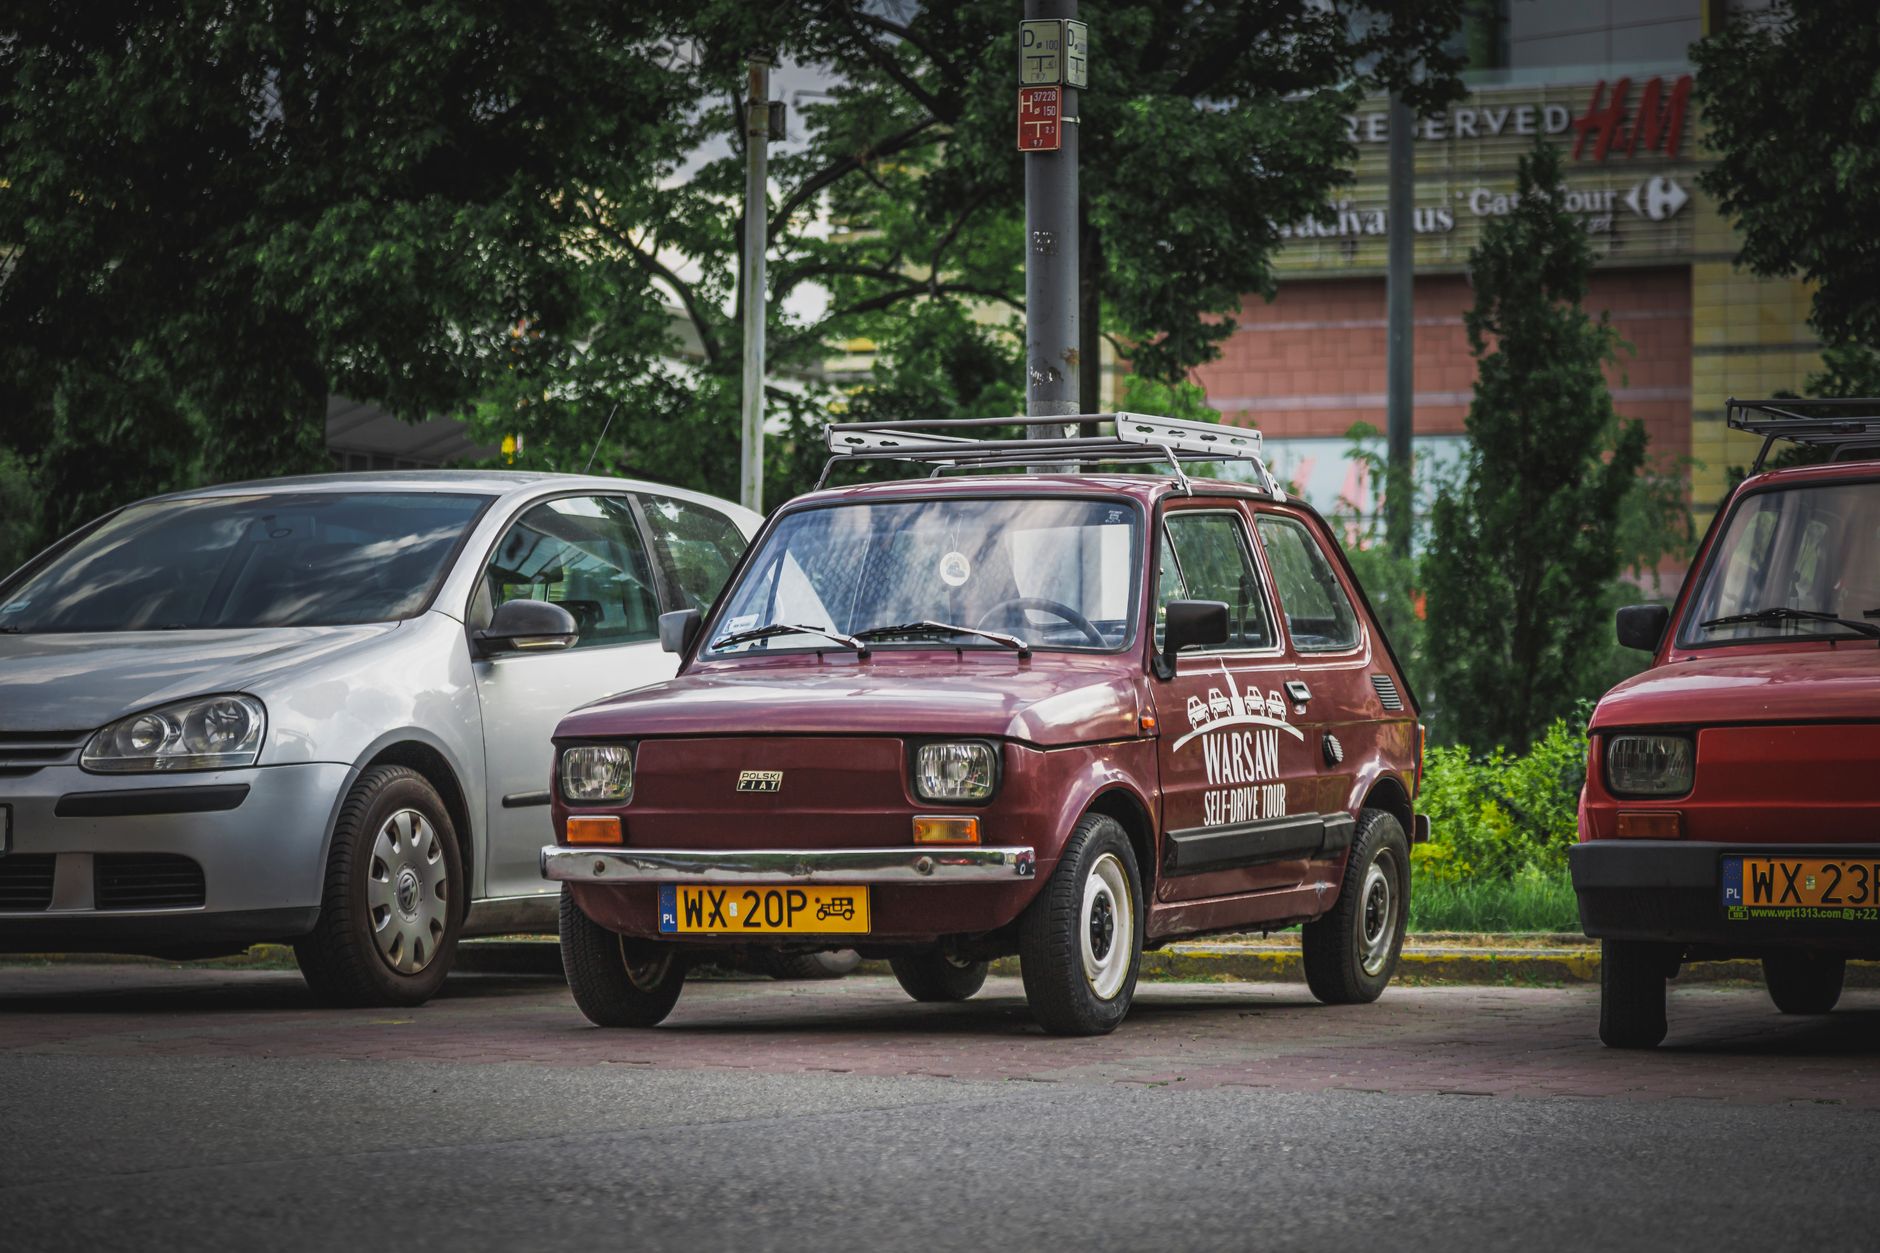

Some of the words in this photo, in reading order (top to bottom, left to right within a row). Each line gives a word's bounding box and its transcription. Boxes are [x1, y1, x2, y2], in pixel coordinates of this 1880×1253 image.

[1033, 91, 1056, 102] 37228
[1021, 95, 1033, 113] H
[1042, 106, 1056, 116] 150
[1342, 105, 1570, 143] REERVED
[1202, 728, 1279, 785] WARSAW
[741, 772, 781, 780] POLSKI
[739, 780, 777, 790] FIAT
[1204, 786, 1259, 826] SELF-DRIVE
[1262, 783, 1287, 819] TOUR
[1752, 863, 1802, 903] WX
[1726, 888, 1741, 899] PL
[683, 890, 728, 928] WX
[742, 890, 808, 928] 20P
[1751, 908, 1841, 920] www.wpt1313.com
[663, 914, 675, 924] PL
